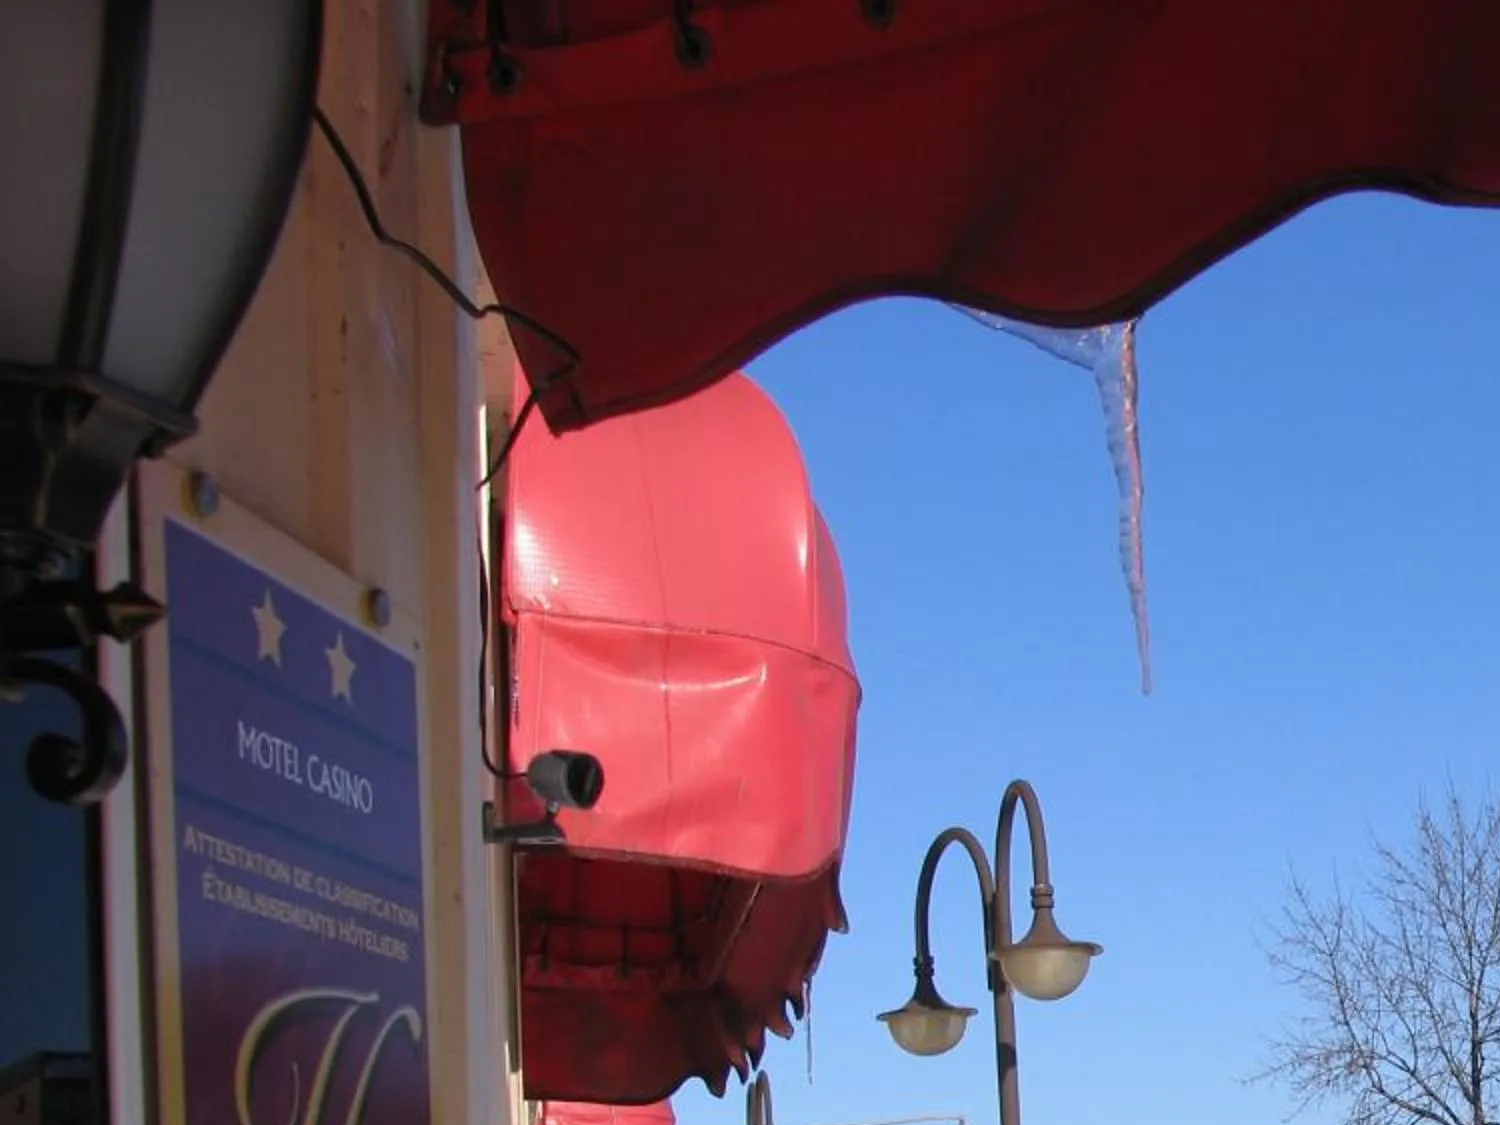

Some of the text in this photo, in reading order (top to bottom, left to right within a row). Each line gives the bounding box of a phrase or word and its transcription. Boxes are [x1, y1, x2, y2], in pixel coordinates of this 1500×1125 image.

[237, 720, 372, 813] MOTEL CASINO
[184, 824, 419, 930] ATTESTATION DE CLASSIFICATION
[203, 865, 409, 962] ÉTABLISSEMENTS HÔTELIERS
